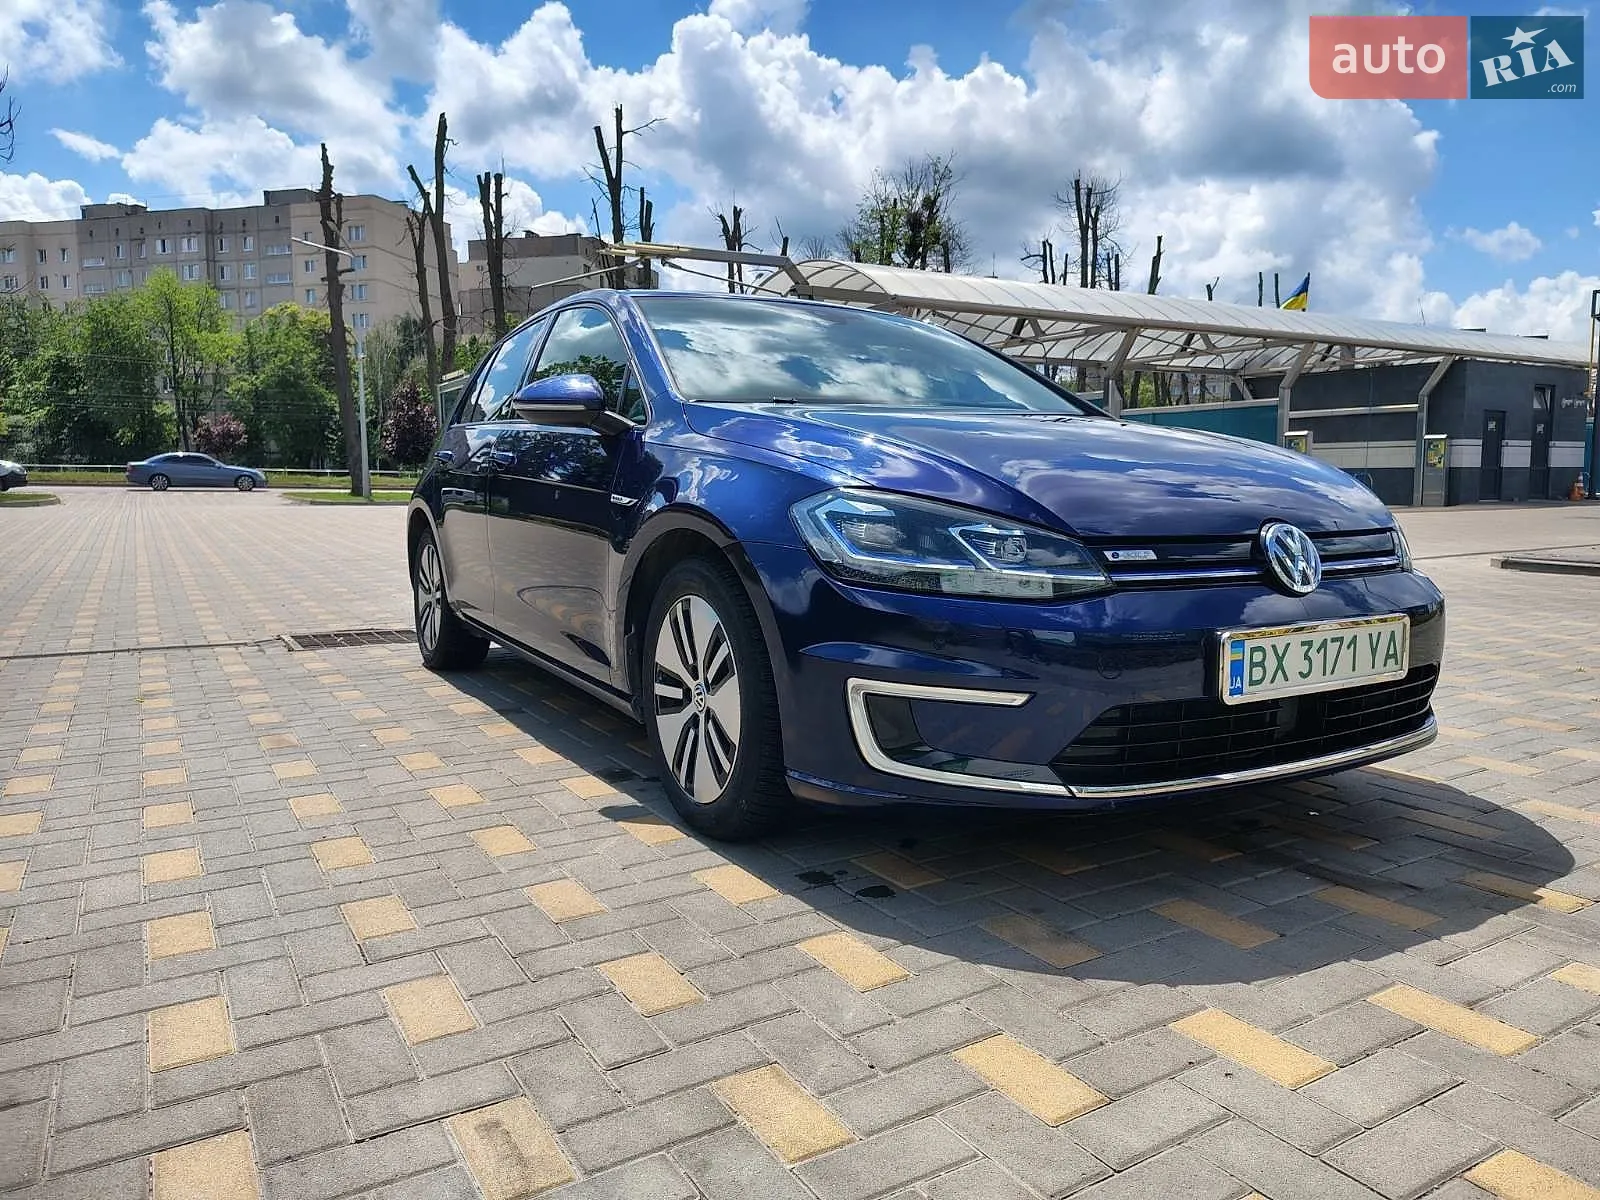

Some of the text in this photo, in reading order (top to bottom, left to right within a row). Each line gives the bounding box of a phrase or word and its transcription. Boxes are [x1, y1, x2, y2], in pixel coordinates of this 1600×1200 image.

[1248, 630, 1399, 687] BX 3171 YA
